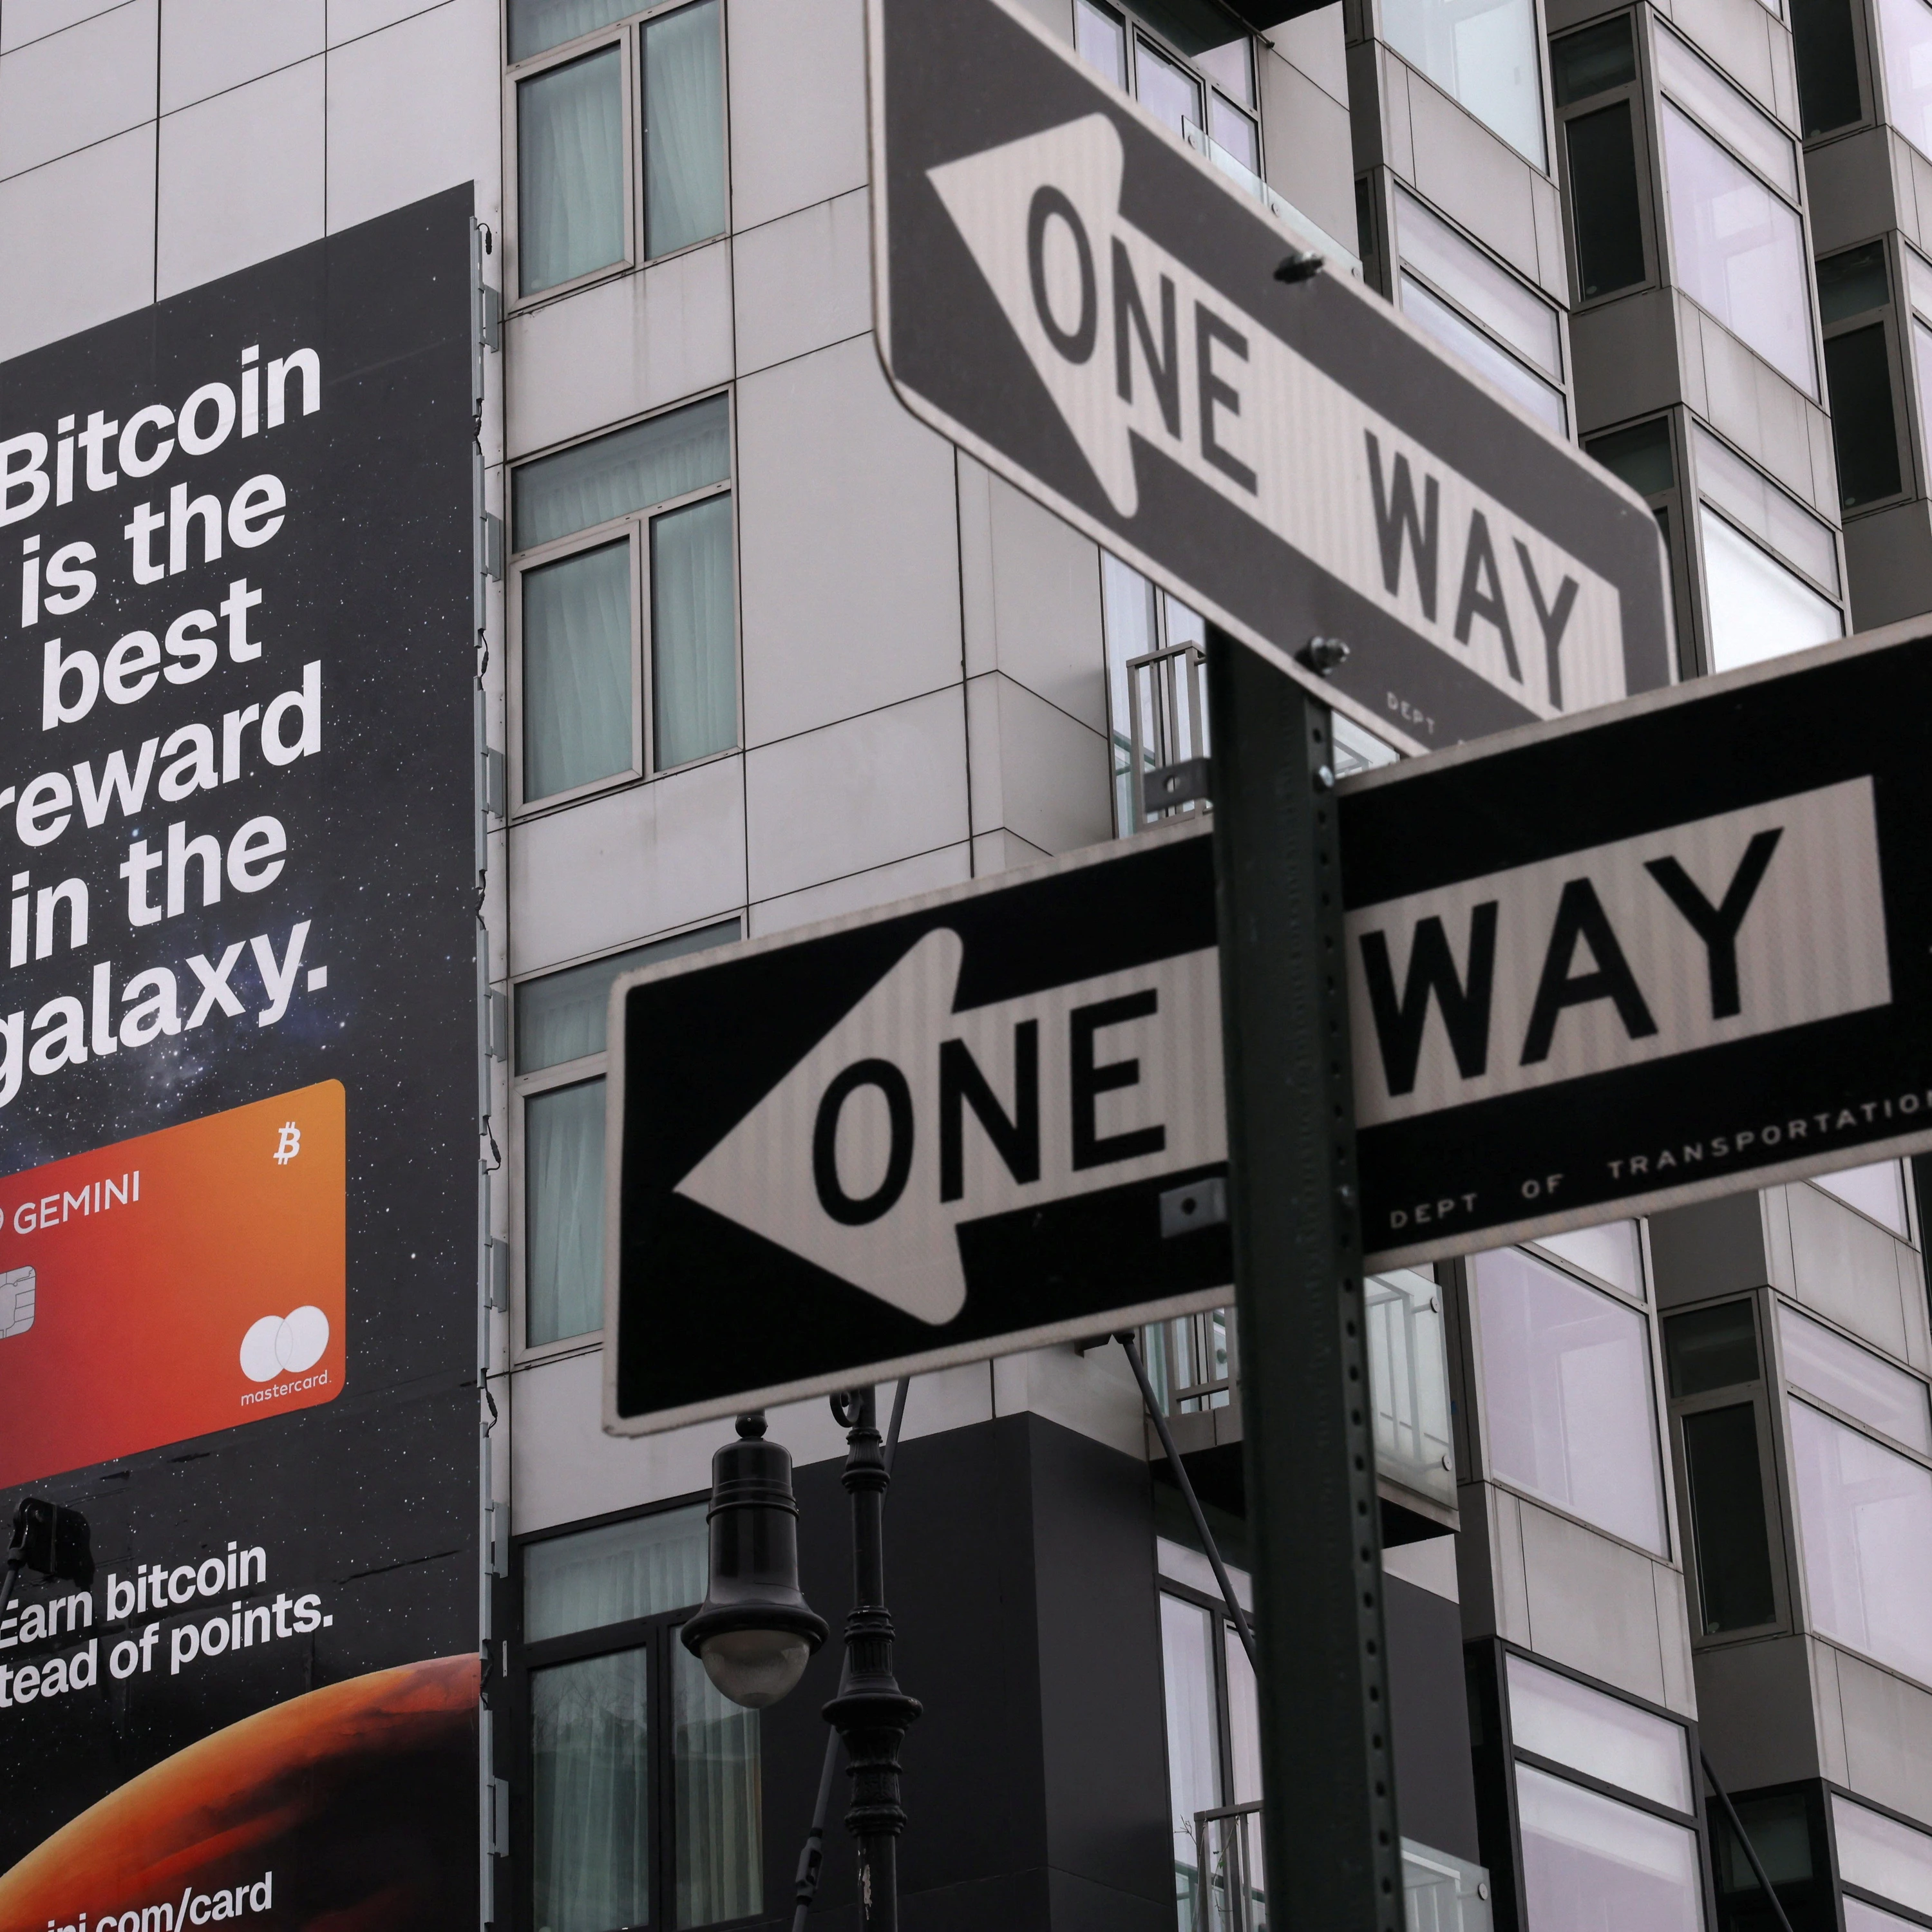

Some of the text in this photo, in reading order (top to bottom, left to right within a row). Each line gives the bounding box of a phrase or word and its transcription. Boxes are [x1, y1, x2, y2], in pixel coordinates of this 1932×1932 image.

[0, 344, 321, 527] Bitcoin
[1027, 184, 1580, 714] ONE WAY
[21, 473, 287, 629] is the
[42, 578, 262, 732] best
[1387, 690, 1435, 735] DEPT
[10, 815, 287, 969] in the
[812, 826, 1785, 1226] ONE WAY
[14, 1170, 140, 1235] GEMINI
[1390, 1089, 1932, 1229] DEPT OF TRANSPORTATIO
[106, 1540, 267, 1622] bitcoin
[109, 1622, 160, 1680] of
[171, 1592, 334, 1676] points.
